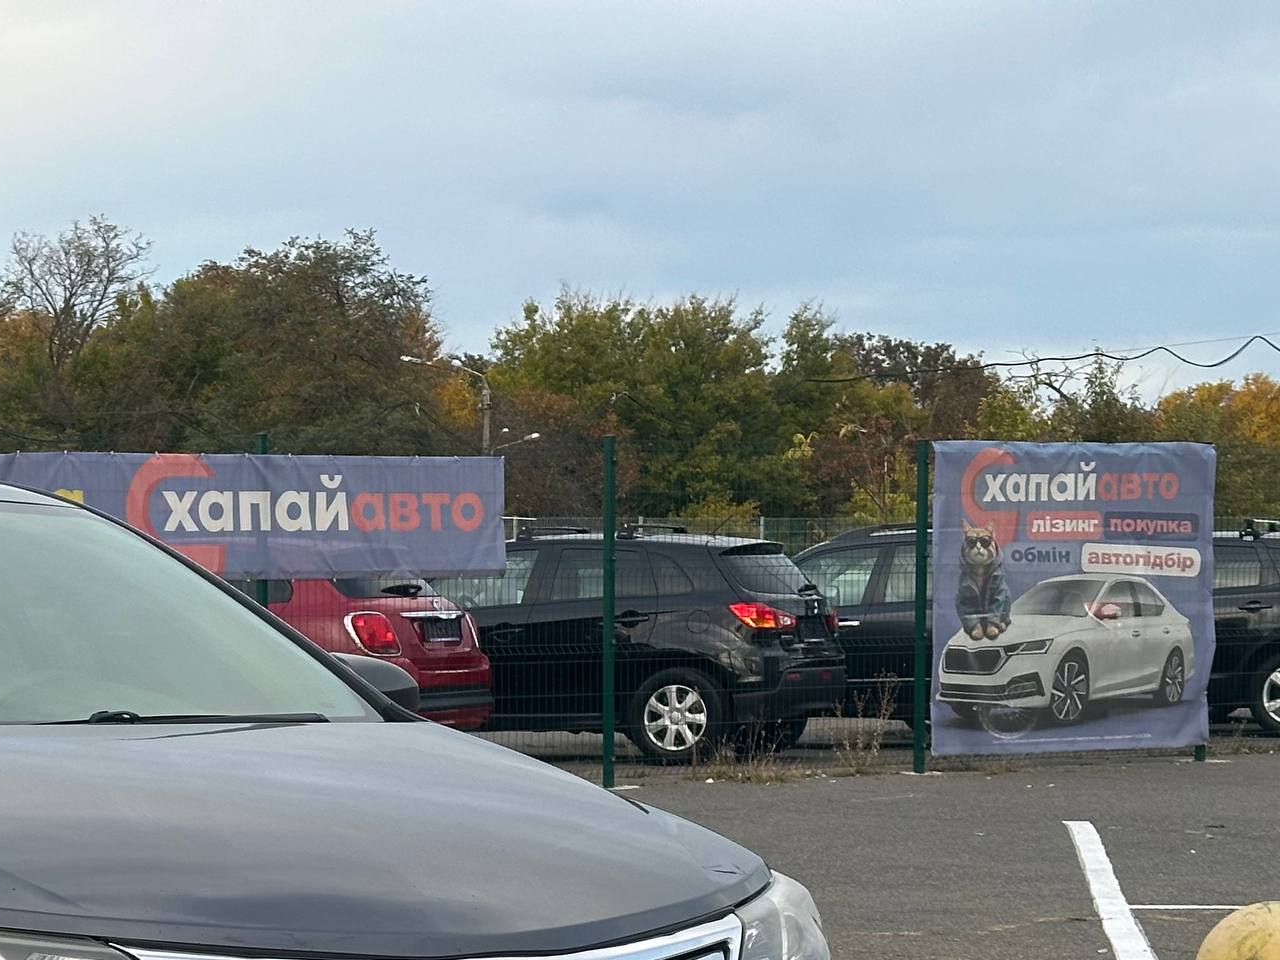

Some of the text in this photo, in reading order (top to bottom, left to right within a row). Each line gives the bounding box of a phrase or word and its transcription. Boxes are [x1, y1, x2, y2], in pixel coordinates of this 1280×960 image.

[1031, 516, 1193, 535] лізинг покупка
[1010, 547, 1195, 572] обмін автопідбір
